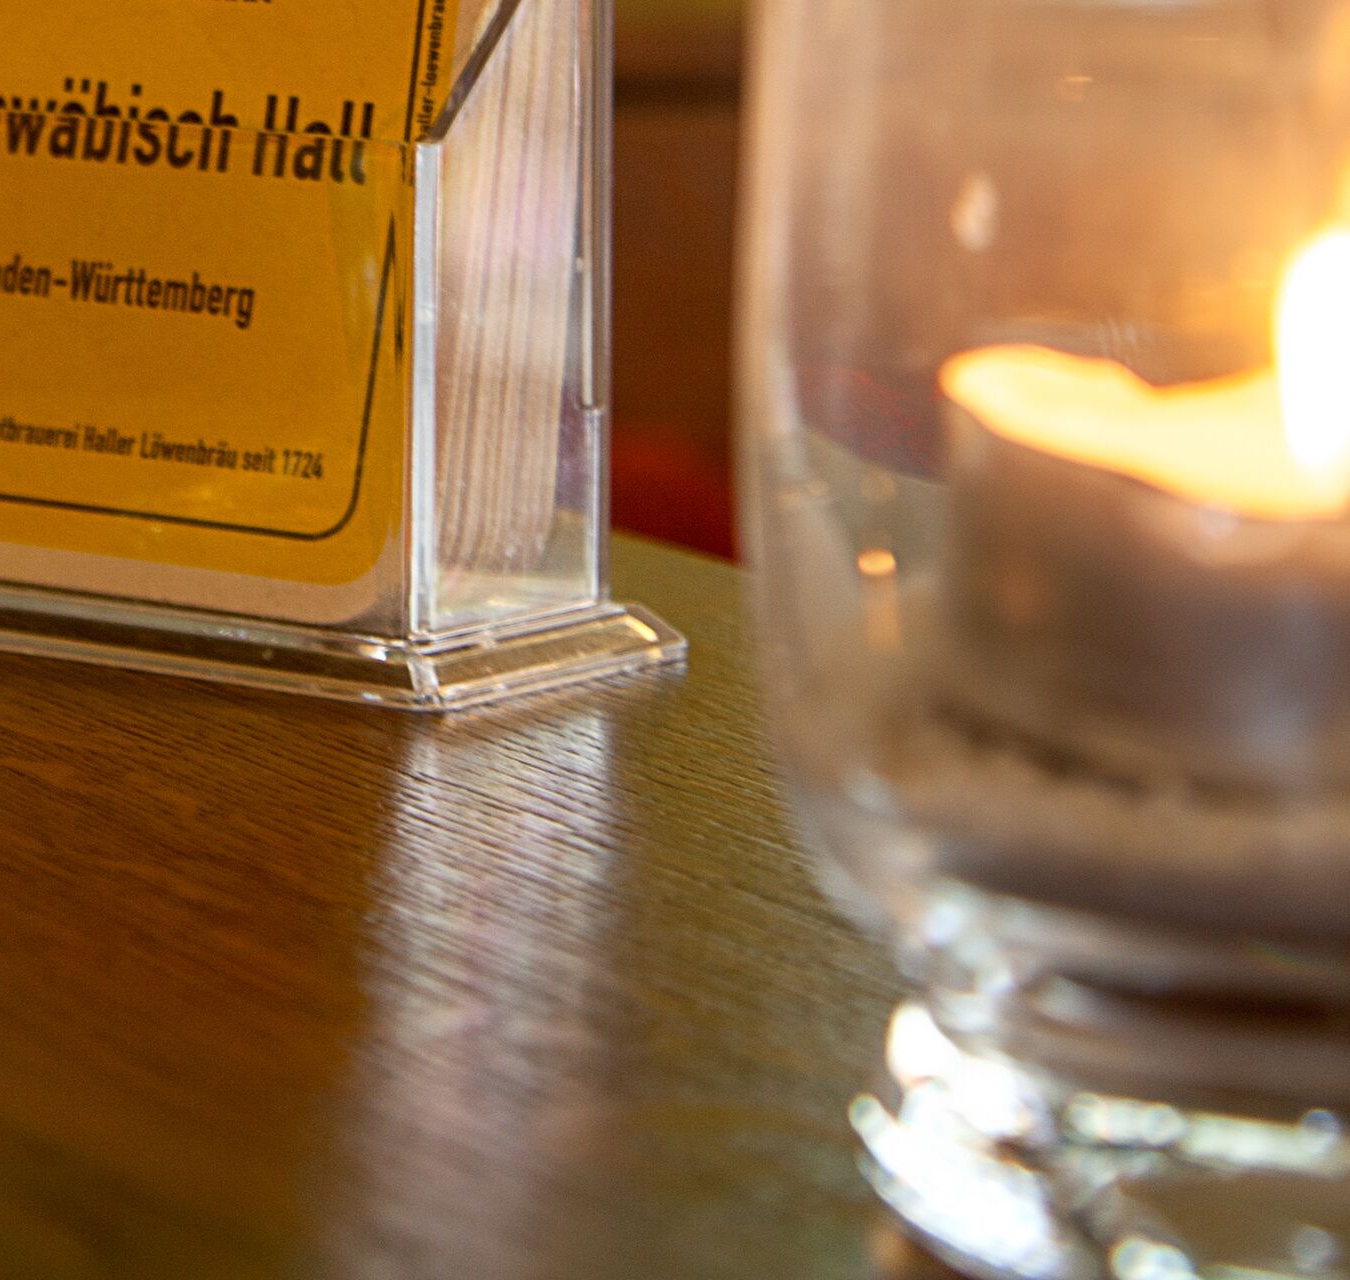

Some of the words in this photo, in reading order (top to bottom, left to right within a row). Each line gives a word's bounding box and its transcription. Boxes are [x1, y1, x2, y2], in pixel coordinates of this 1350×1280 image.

[252, 93, 376, 186] Hall
[82, 425, 135, 457] Haller
[139, 431, 238, 470] Löwenbräu
[241, 445, 276, 475] seit
[281, 449, 325, 481] 1724
